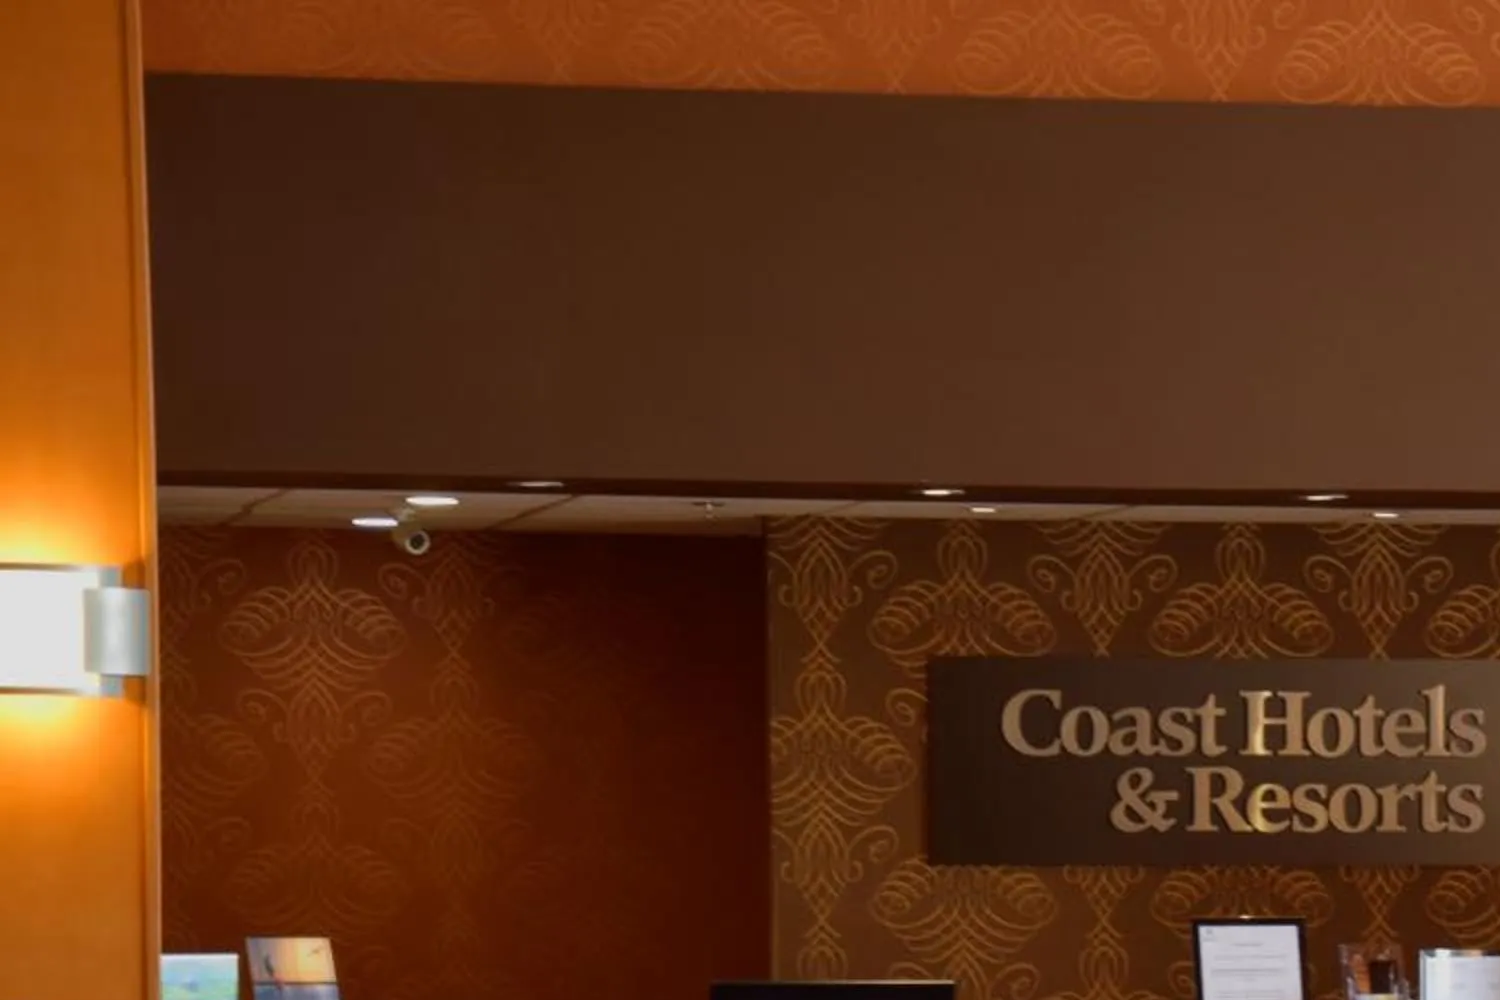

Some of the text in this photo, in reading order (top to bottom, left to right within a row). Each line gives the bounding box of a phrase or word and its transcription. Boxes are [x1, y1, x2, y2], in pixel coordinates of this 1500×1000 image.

[1001, 685, 1486, 758] Coast Hotels
[1111, 767, 1486, 834] & Resorts
